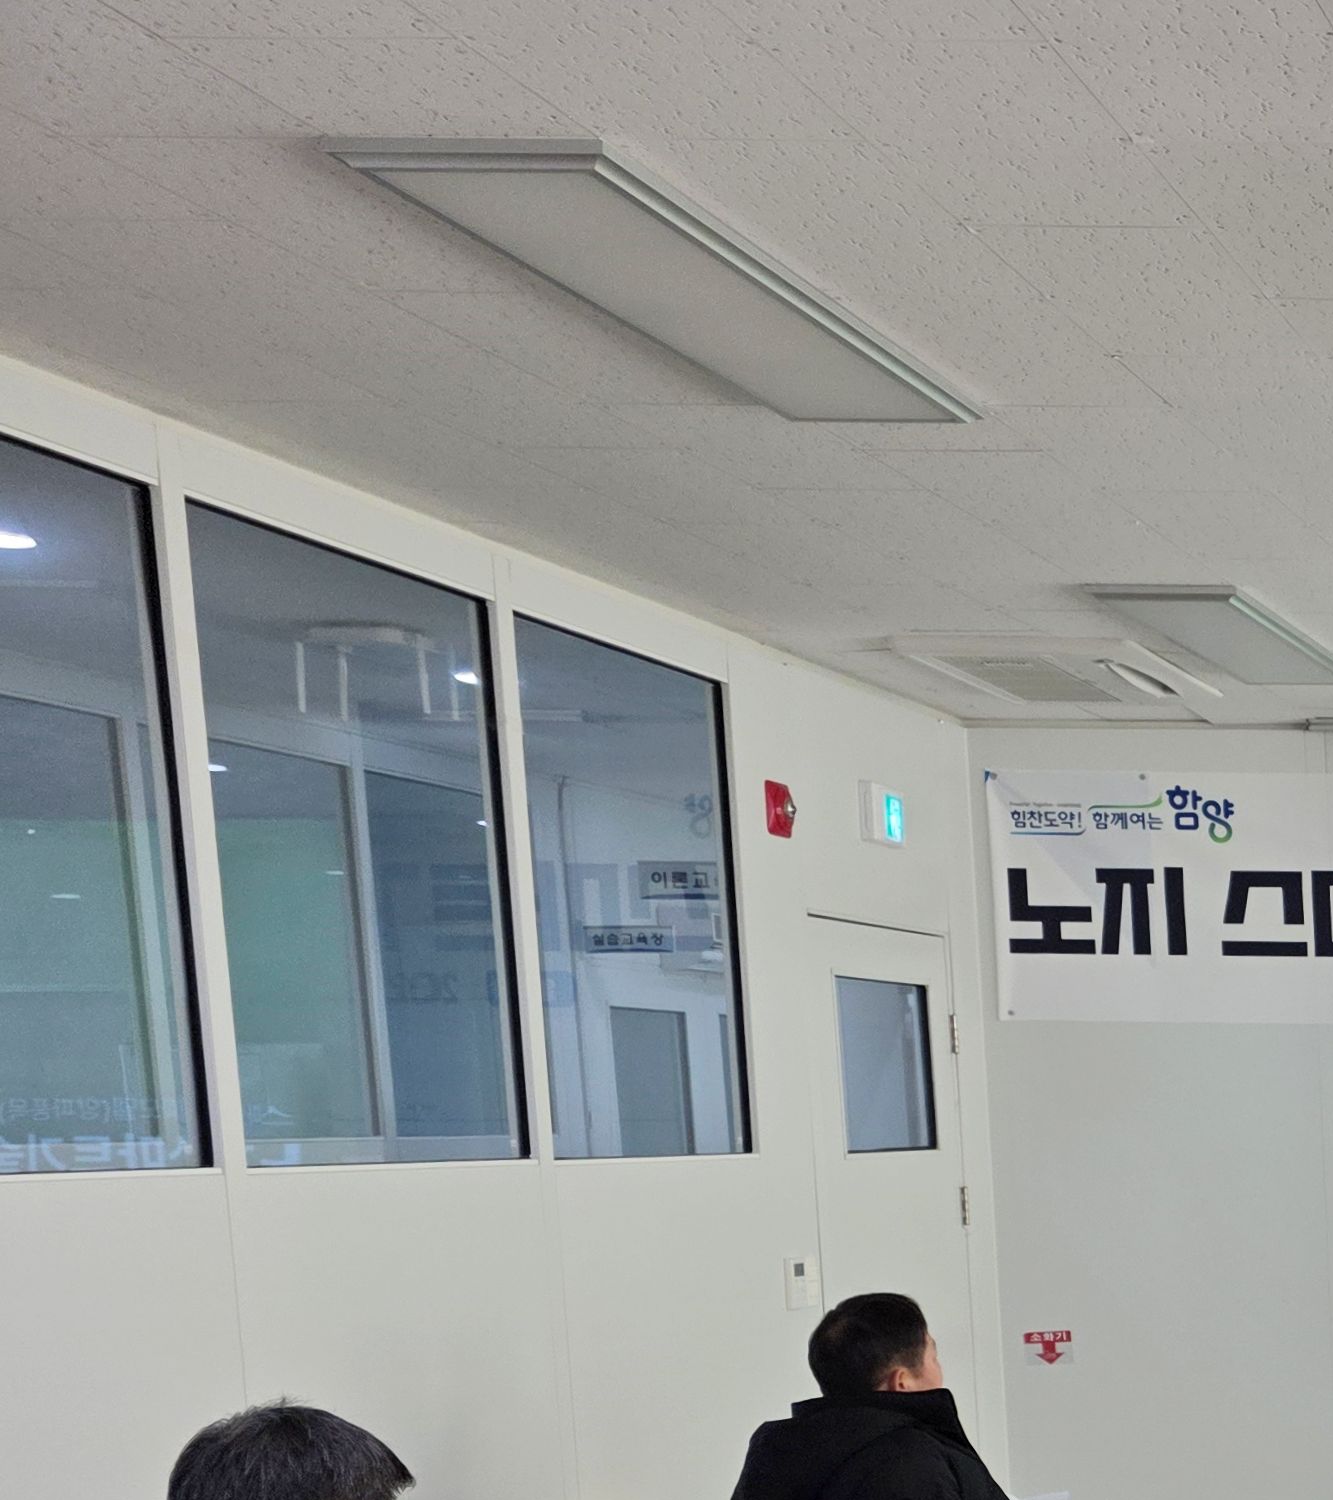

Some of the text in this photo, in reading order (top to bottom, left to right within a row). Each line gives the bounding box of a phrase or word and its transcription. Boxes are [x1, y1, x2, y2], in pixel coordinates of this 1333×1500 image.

[1011, 785, 1235, 844] 힘찬도약! 함께여는 함양
[650, 871, 718, 889] 이론교
[1007, 866, 1189, 956] 노지
